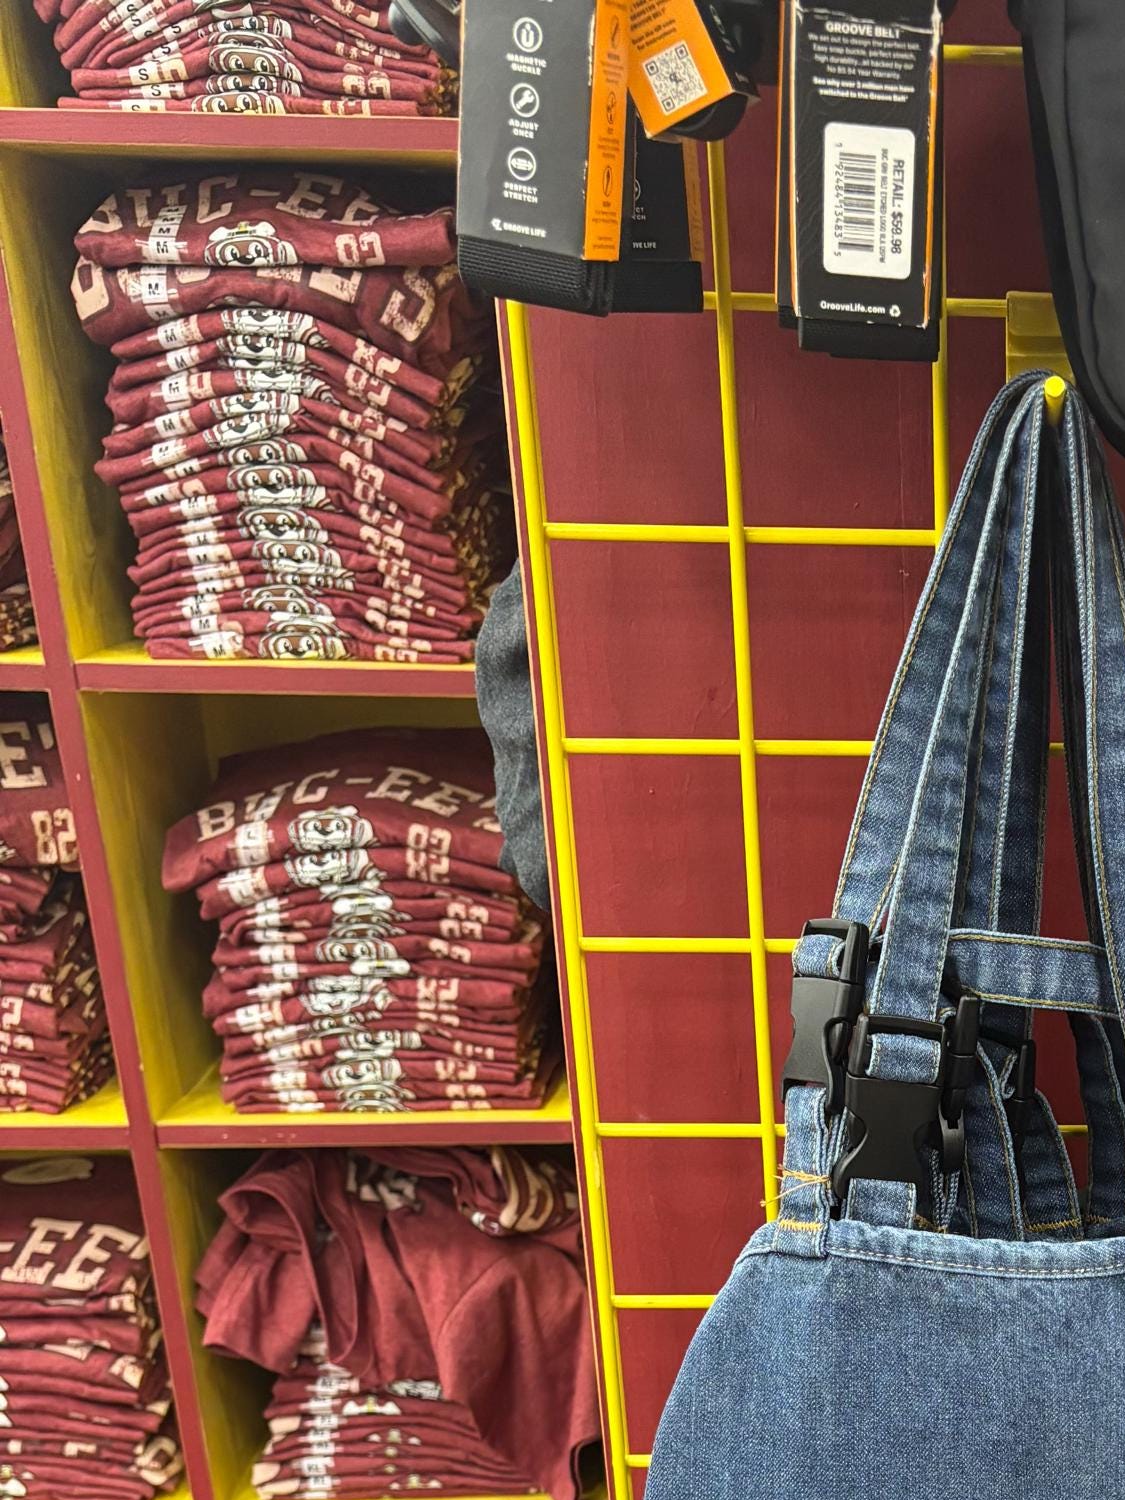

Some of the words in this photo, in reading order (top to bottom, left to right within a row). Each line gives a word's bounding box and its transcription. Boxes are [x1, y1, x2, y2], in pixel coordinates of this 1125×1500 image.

[825, 21, 872, 36] GROOVE
[874, 26, 900, 39] BELT
[506, 53, 547, 68] MAGNETIC
[138, 68, 150, 80] S
[511, 62, 542, 76] BUCKLE
[150, 84, 162, 96] S
[508, 118, 540, 132] ADJUST
[512, 129, 534, 139] ONCE
[504, 182, 538, 196] PERFECT
[892, 159, 904, 208] RETAIL:
[504, 190, 538, 204] STRETCH
[502, 222, 530, 236] GROOVE
[530, 226, 546, 238] LIFE
[820, 300, 886, 314] GrooveLife.com
[30, 808, 80, 864] 82
